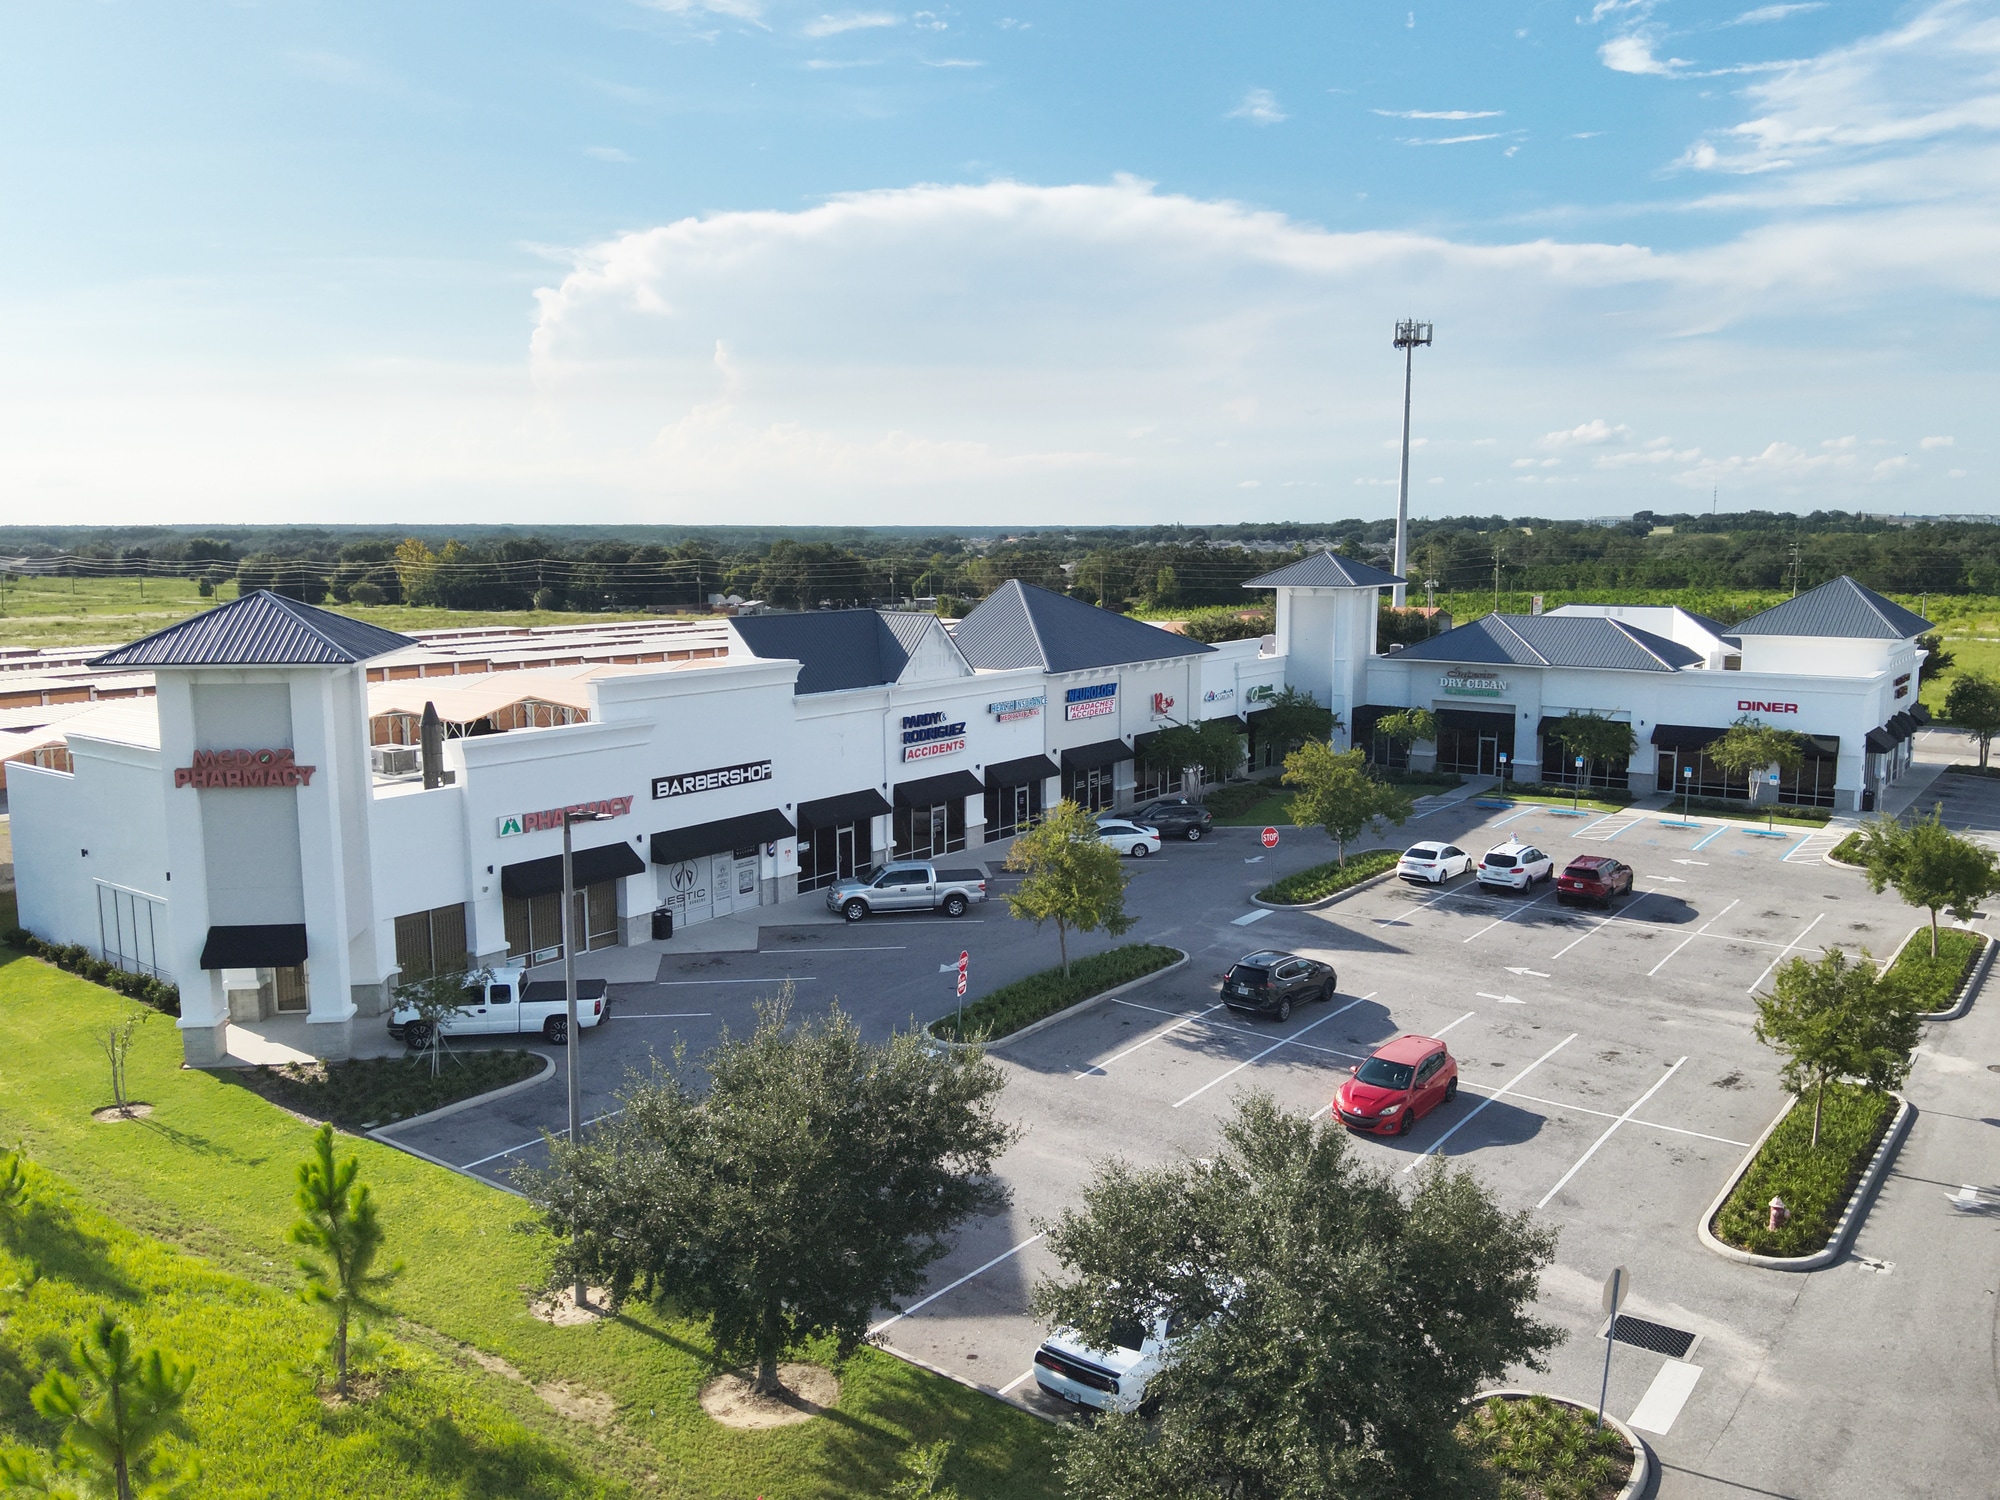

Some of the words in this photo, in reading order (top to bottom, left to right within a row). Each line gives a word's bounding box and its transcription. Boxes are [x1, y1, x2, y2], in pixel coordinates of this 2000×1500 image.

[1440, 678, 1463, 687] DRY
[1466, 679, 1507, 690] CLEAN
[1067, 683, 1117, 703] NEUROLOGY
[991, 700, 1014, 713] HEALTH
[1070, 700, 1114, 712] HEADACHES
[1072, 707, 1113, 719] ACCIDENTS
[1737, 700, 1798, 714] DINER
[902, 711, 940, 729] PARDY
[903, 722, 966, 744] RODRIGUEZ
[907, 740, 965, 760] ACCIDENTS
[174, 766, 316, 788] PHARMACY
[656, 764, 772, 797] BARBERSHOP
[1263, 833, 1277, 842] STOP
